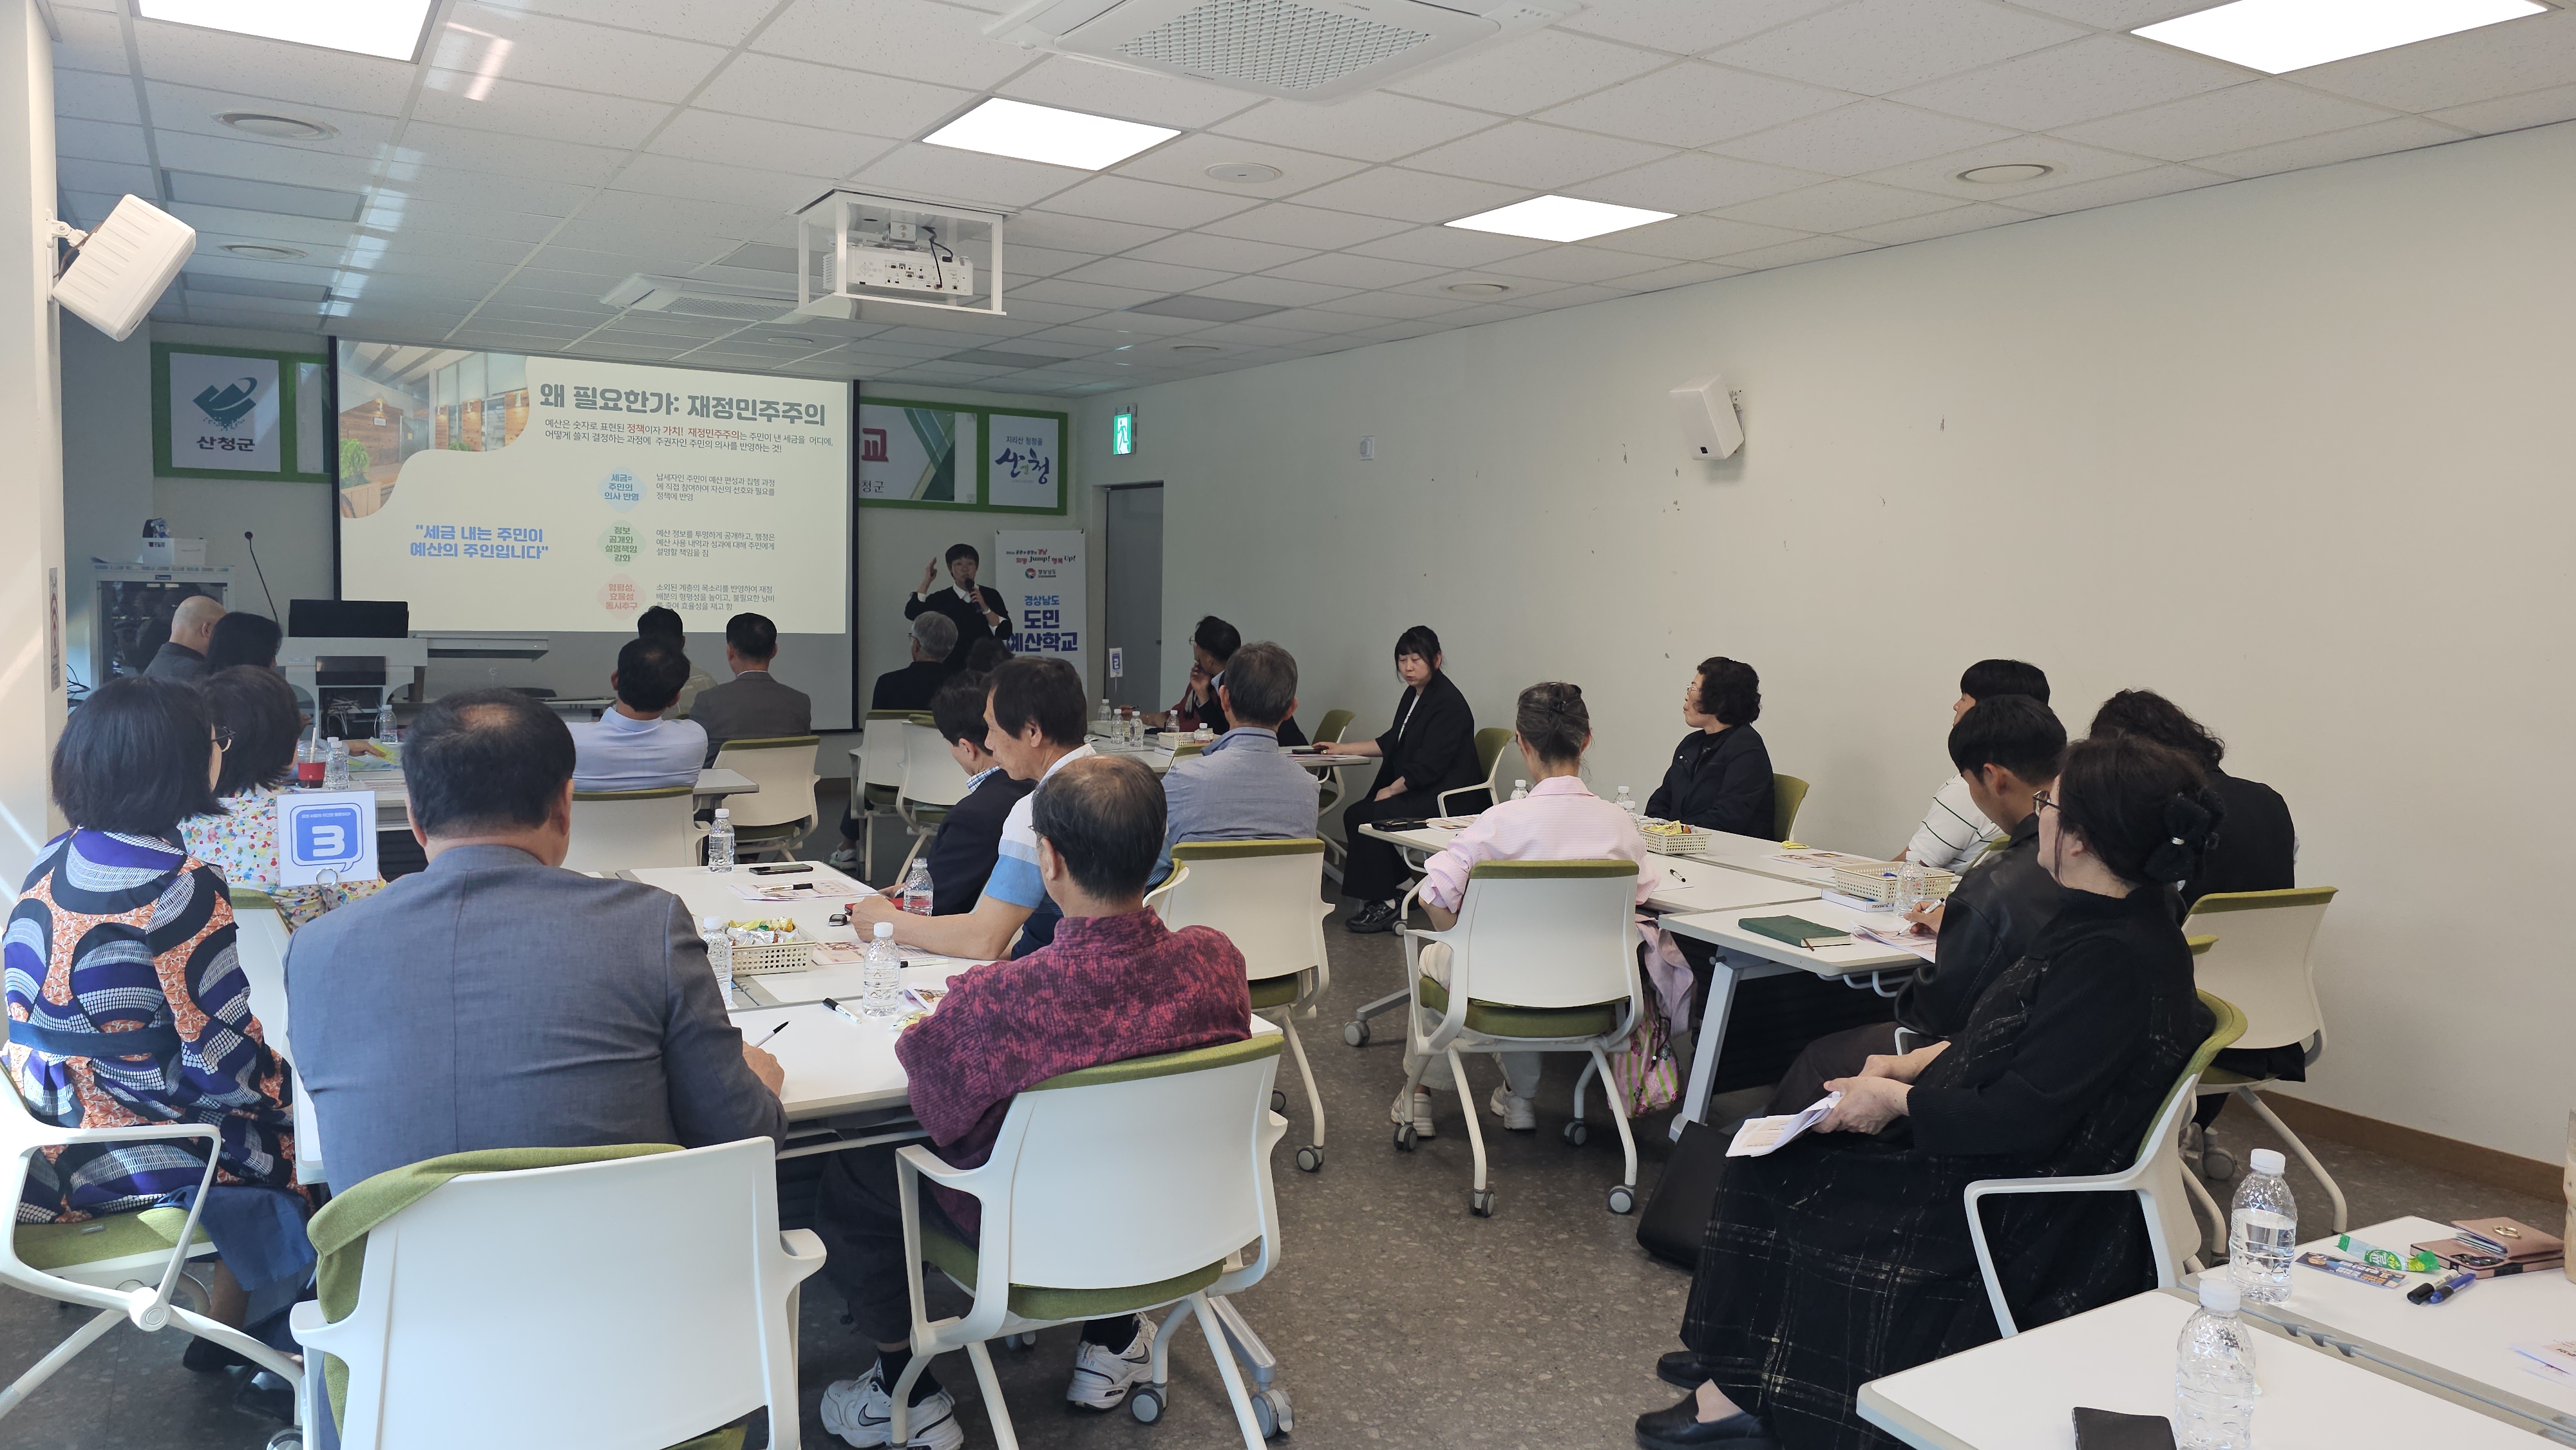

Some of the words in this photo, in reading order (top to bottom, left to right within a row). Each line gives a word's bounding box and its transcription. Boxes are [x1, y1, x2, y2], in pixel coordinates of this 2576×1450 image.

[540, 383, 565, 408] 왜
[573, 386, 679, 416] 필요한가:
[687, 395, 826, 426] 재정민주주의
[545, 419, 571, 429] 예산은
[573, 420, 598, 431] 숫자로
[600, 422, 625, 433] 표현된
[627, 423, 661, 435] 정책이자
[663, 426, 684, 437] 가치!
[688, 427, 748, 440] 재정민주주의는
[749, 432, 772, 443] 주민이
[773, 433, 782, 443] 낸
[783, 434, 806, 445] 세금을
[809, 436, 833, 447] 어디에,
[196, 436, 256, 452] 산청군
[545, 429, 571, 440] 어떻게
[573, 431, 589, 442] 쓸지
[592, 433, 625, 444] 결정하는
[627, 434, 651, 446] 과정에
[655, 436, 687, 447] 주권자인
[688, 438, 712, 449] 주민의
[714, 440, 738, 451] 의사를
[740, 442, 770, 453] 반영하는
[772, 444, 782, 453] 것!
[1006, 436, 1024, 445] 지리산
[1025, 437, 1043, 446] 청정골
[611, 473, 632, 482] 세금=
[656, 473, 685, 483] 납세자인
[686, 475, 707, 484] 주민이
[708, 475, 723, 484] 예산
[724, 476, 744, 485] 편성과
[746, 478, 760, 487] 집행
[761, 478, 775, 487] 과정
[608, 482, 633, 492] 주민의
[656, 482, 664, 491] 에
[665, 482, 679, 492] 직접
[681, 484, 709, 493] 참여하여
[710, 485, 732, 494] 자신의
[733, 486, 753, 495] 선호와
[755, 487, 775, 496] 필요를
[858, 480, 885, 493] 청군
[604, 491, 621, 500] 의사
[623, 492, 639, 502] 반영
[656, 491, 677, 501] 정책에
[679, 493, 694, 502] 반영
[415, 524, 456, 540] "세금
[460, 526, 492, 541] 내는
[497, 527, 543, 543] 주민이
[614, 526, 630, 535] 정보
[656, 529, 670, 538] 예산
[672, 529, 693, 539] 정보를
[694, 531, 723, 540] 투명하게
[724, 532, 753, 541] 공개하고,
[755, 532, 775, 541] 행정은
[609, 535, 634, 544] 공개와
[656, 538, 670, 547] 예산
[672, 539, 687, 548] 사용
[688, 540, 709, 549] 내역과
[710, 540, 732, 549] 성과에
[733, 541, 746, 550] 대해
[748, 541, 775, 551] 주민에게
[410, 541, 459, 558] 예산의
[463, 543, 549, 560] 주인입니다"
[605, 544, 638, 553] 설명책임
[656, 547, 677, 557] 설명할
[679, 548, 701, 558] 책임을
[614, 553, 630, 562] 강화
[1029, 555, 1051, 563] Jump!
[608, 583, 636, 592] 형평성,
[656, 583, 677, 592] 소외된
[679, 583, 700, 592] 계층의
[701, 584, 729, 593] 목소리를
[730, 585, 757, 593] 반영하여
[759, 585, 773, 594] 재정
[609, 592, 634, 601] 효율성
[656, 592, 677, 601] 배분의
[679, 592, 706, 602] 형평성을
[708, 593, 731, 603] 높이고,
[732, 594, 760, 603] 불필요한
[761, 594, 775, 603] 낭비
[1024, 595, 1060, 606] 경상남도
[605, 601, 638, 610] 동시추구
[681, 603, 708, 611] 효율성을
[710, 603, 724, 611] 제고
[1024, 609, 1060, 629] 도민
[1007, 632, 1078, 652] 예산학교
[312, 825, 345, 857] 3
